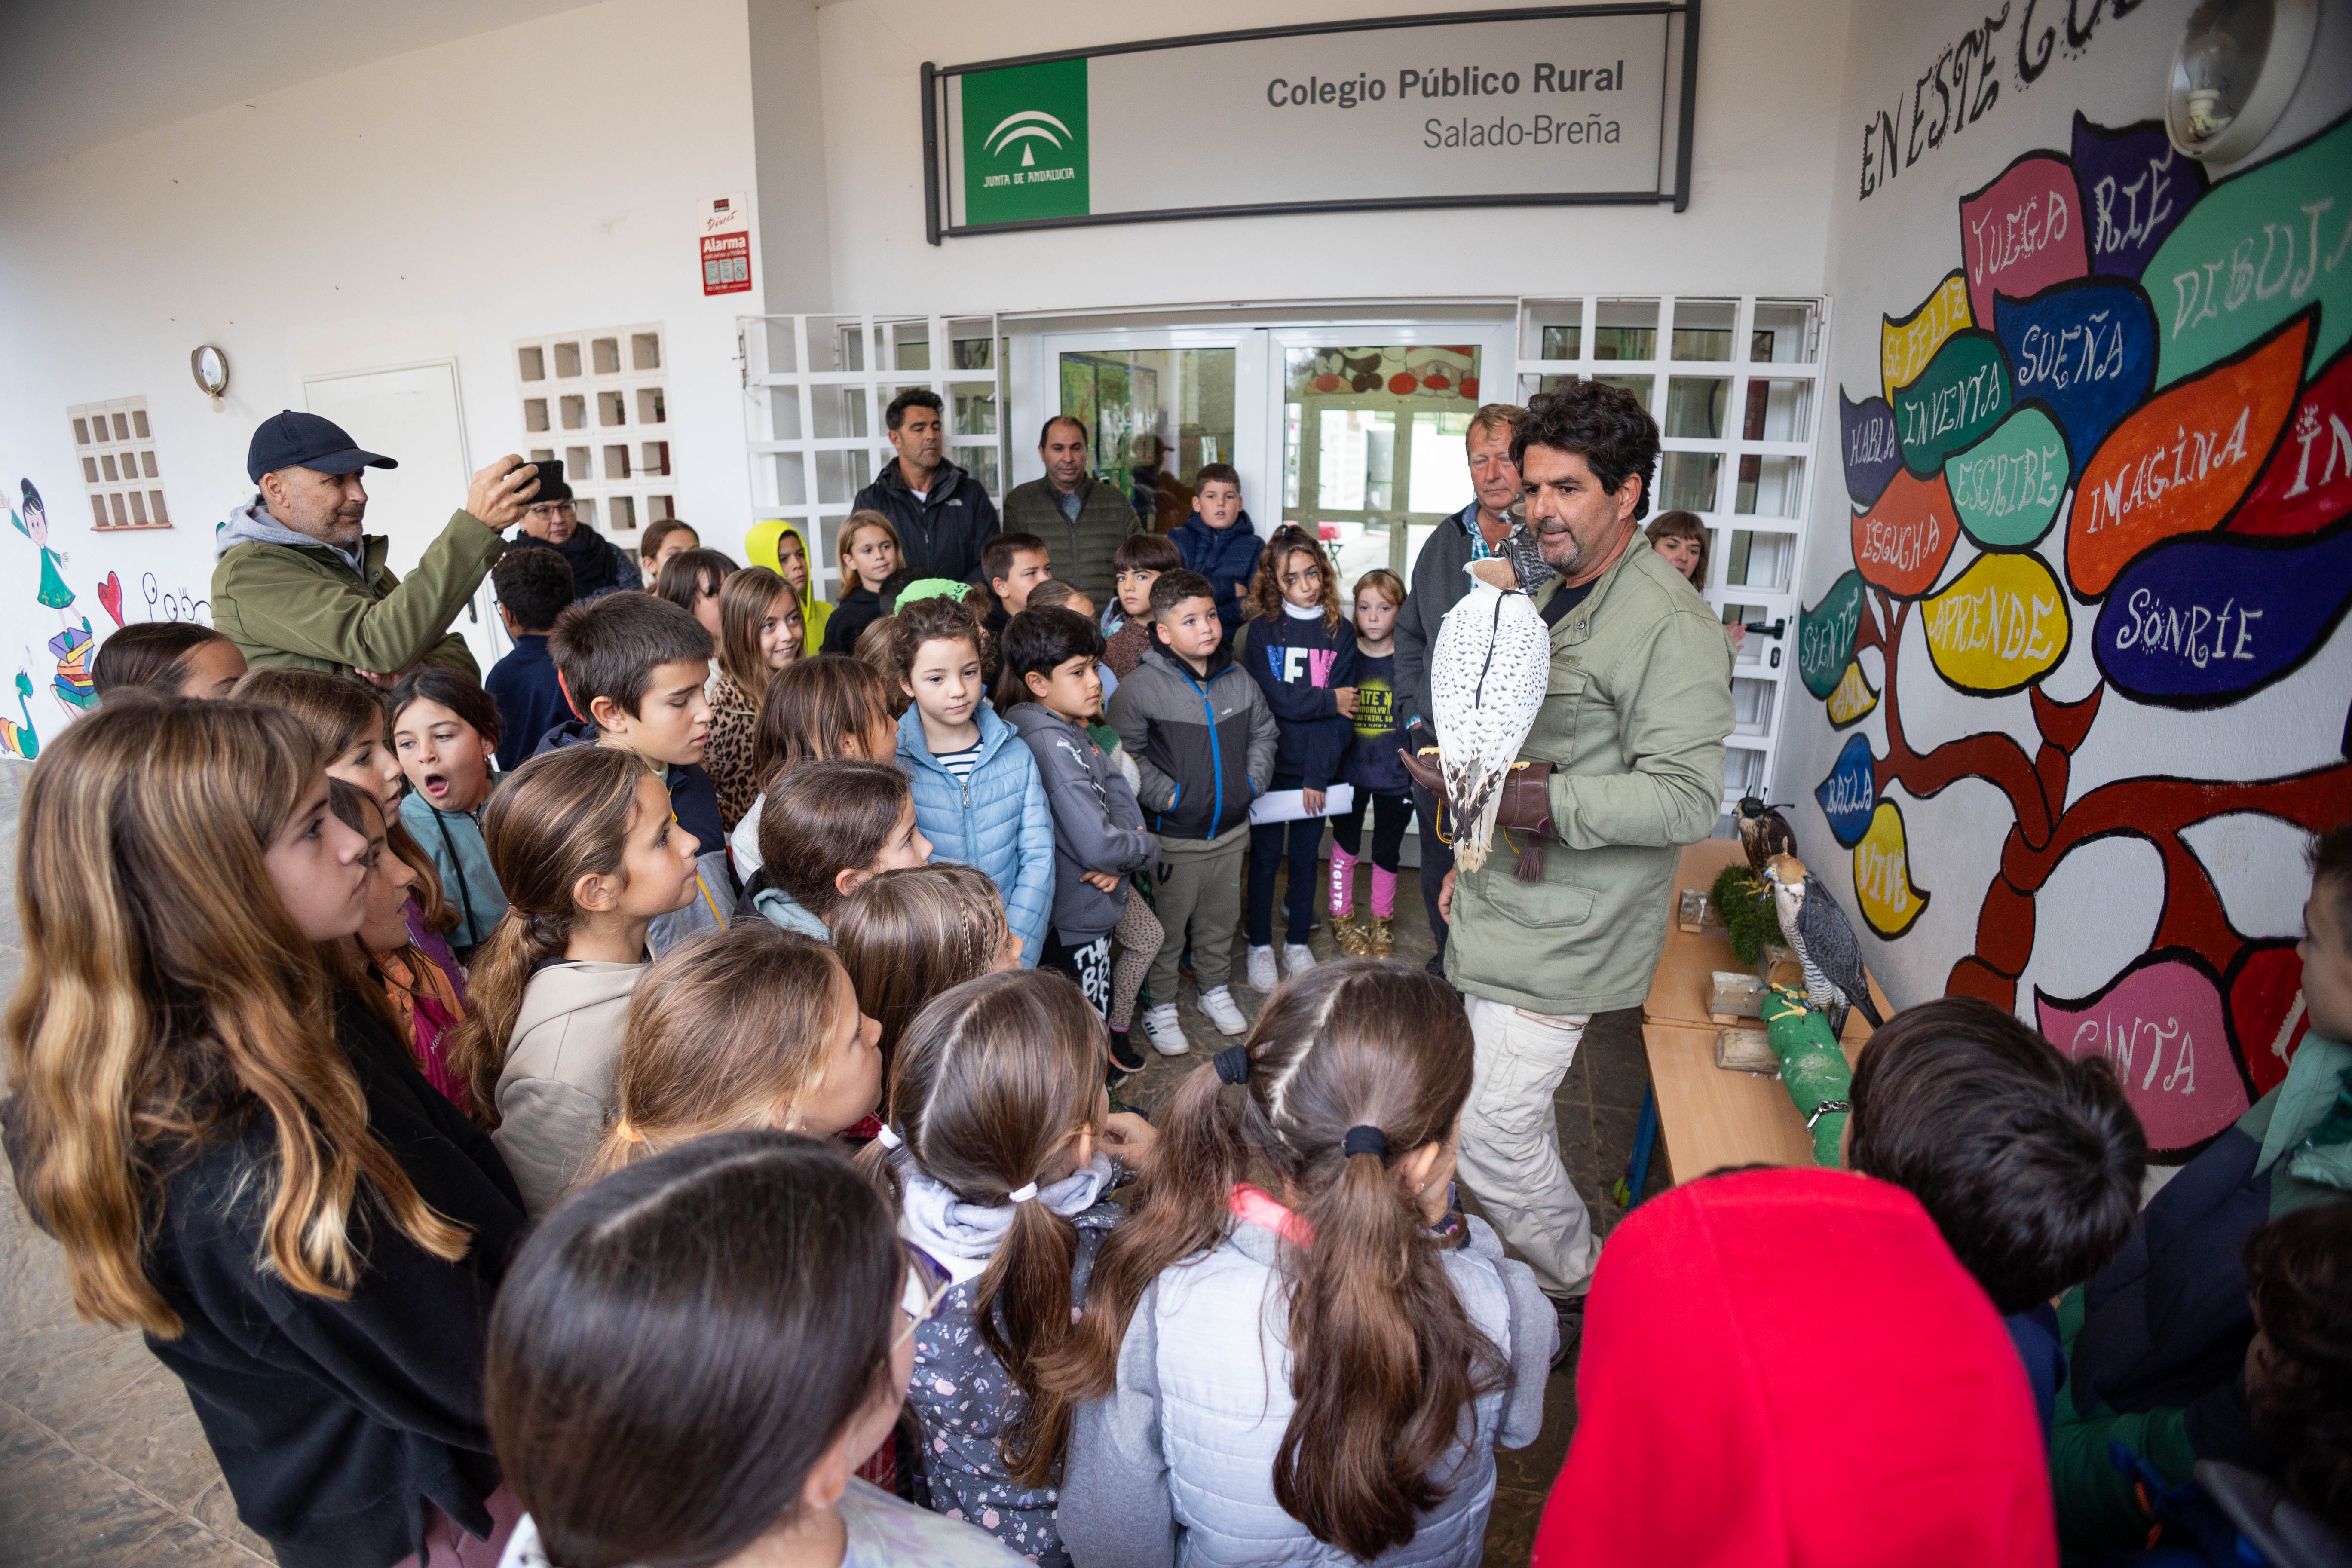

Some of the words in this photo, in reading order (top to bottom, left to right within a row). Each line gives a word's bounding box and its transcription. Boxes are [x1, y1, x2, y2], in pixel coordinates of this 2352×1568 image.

[1267, 72, 1386, 108] Colegio
[1399, 66, 1520, 99] Público
[1534, 60, 1623, 93] Rural
[1423, 113, 1620, 148] Salado-Breña
[984, 175, 1010, 187] JUNTA
[1013, 173, 1025, 184] DE
[2094, 147, 2173, 254] RIE
[704, 237, 746, 253] Alarma
[1972, 190, 2067, 286] JUEGA
[2018, 309, 2122, 389] SUEÑA
[1904, 362, 2001, 445] INVENTA
[1850, 417, 1894, 467] HABLA
[2086, 406, 2249, 533] IMAGINA
[1956, 443, 2058, 518] ESCRIBE
[1862, 514, 1940, 572] ESCUCHA
[1929, 585, 2055, 662] APRENDE
[1826, 767, 1873, 815] BAILA
[1860, 842, 1907, 913] VIVE
